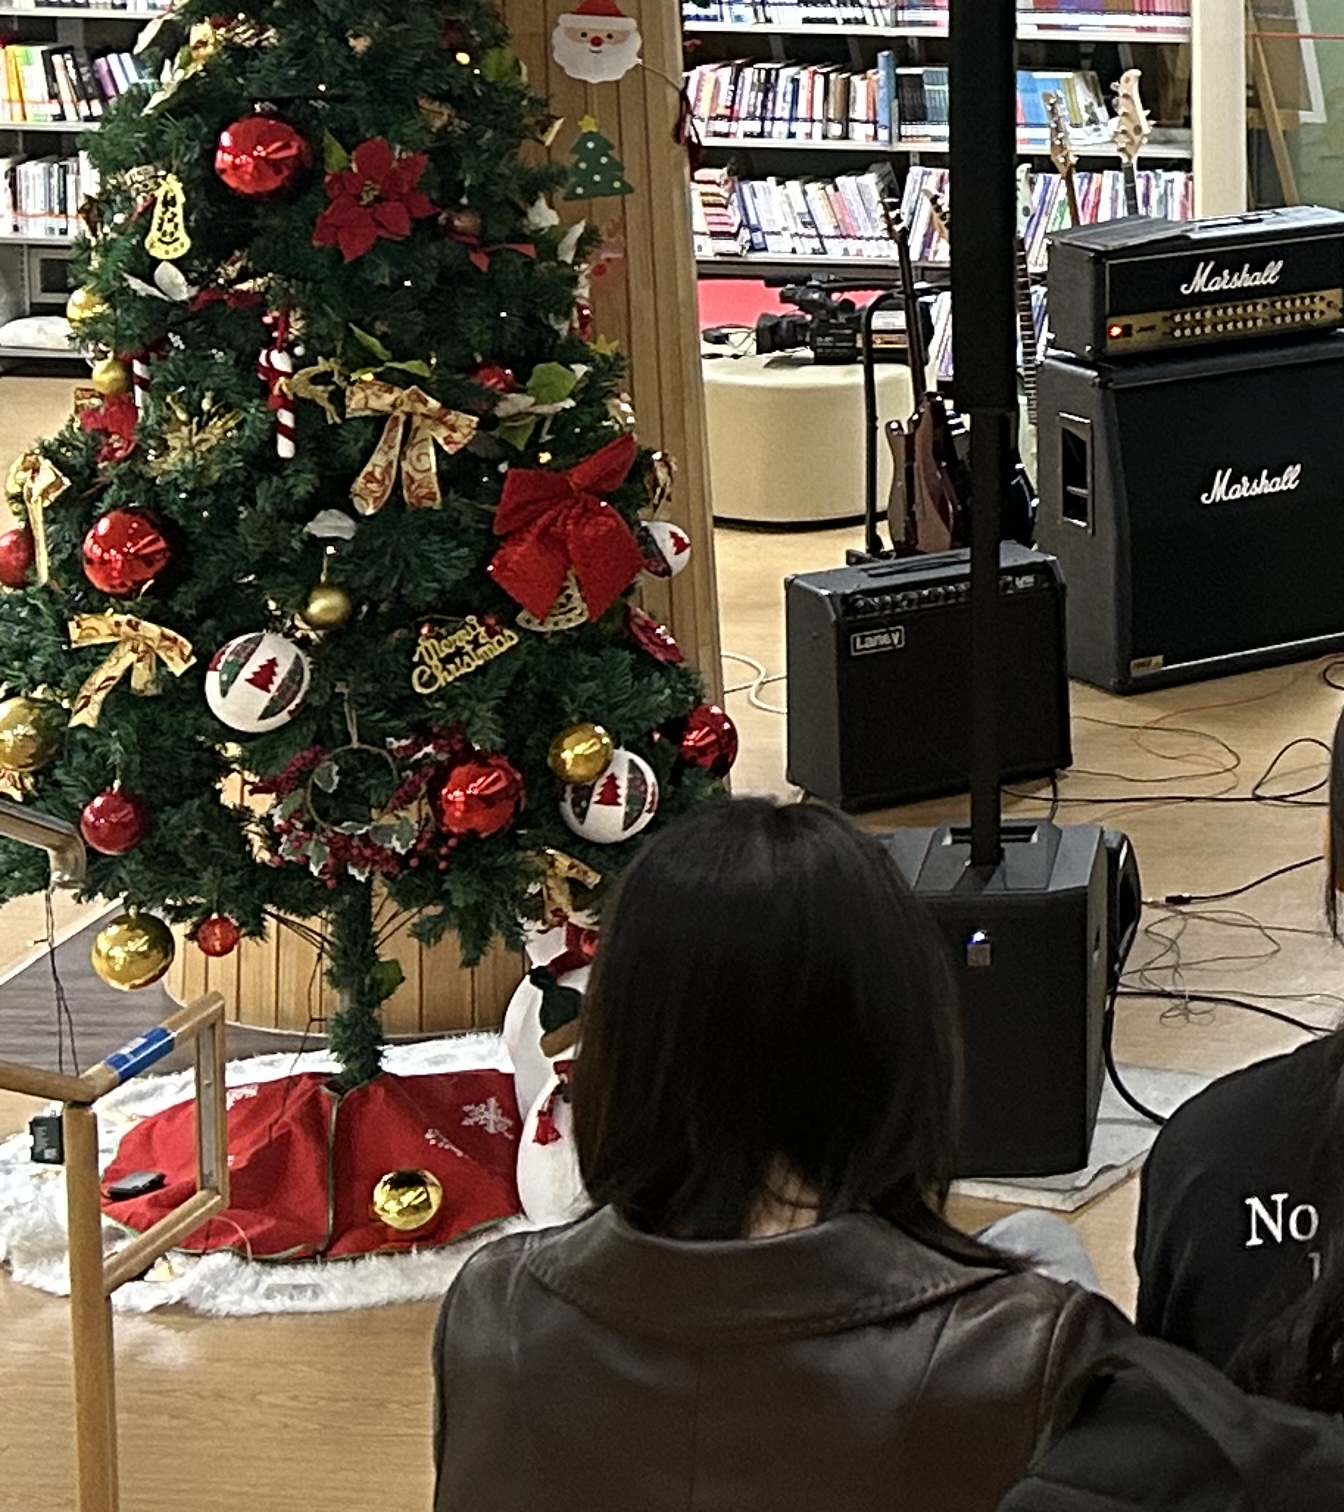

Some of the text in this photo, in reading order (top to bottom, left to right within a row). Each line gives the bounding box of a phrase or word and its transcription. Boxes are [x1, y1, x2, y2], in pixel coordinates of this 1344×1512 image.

[1180, 260, 1284, 295] Marshall
[1200, 464, 1301, 504] Marshall
[856, 631, 900, 650] Laney
[1245, 1192, 1319, 1247] No
